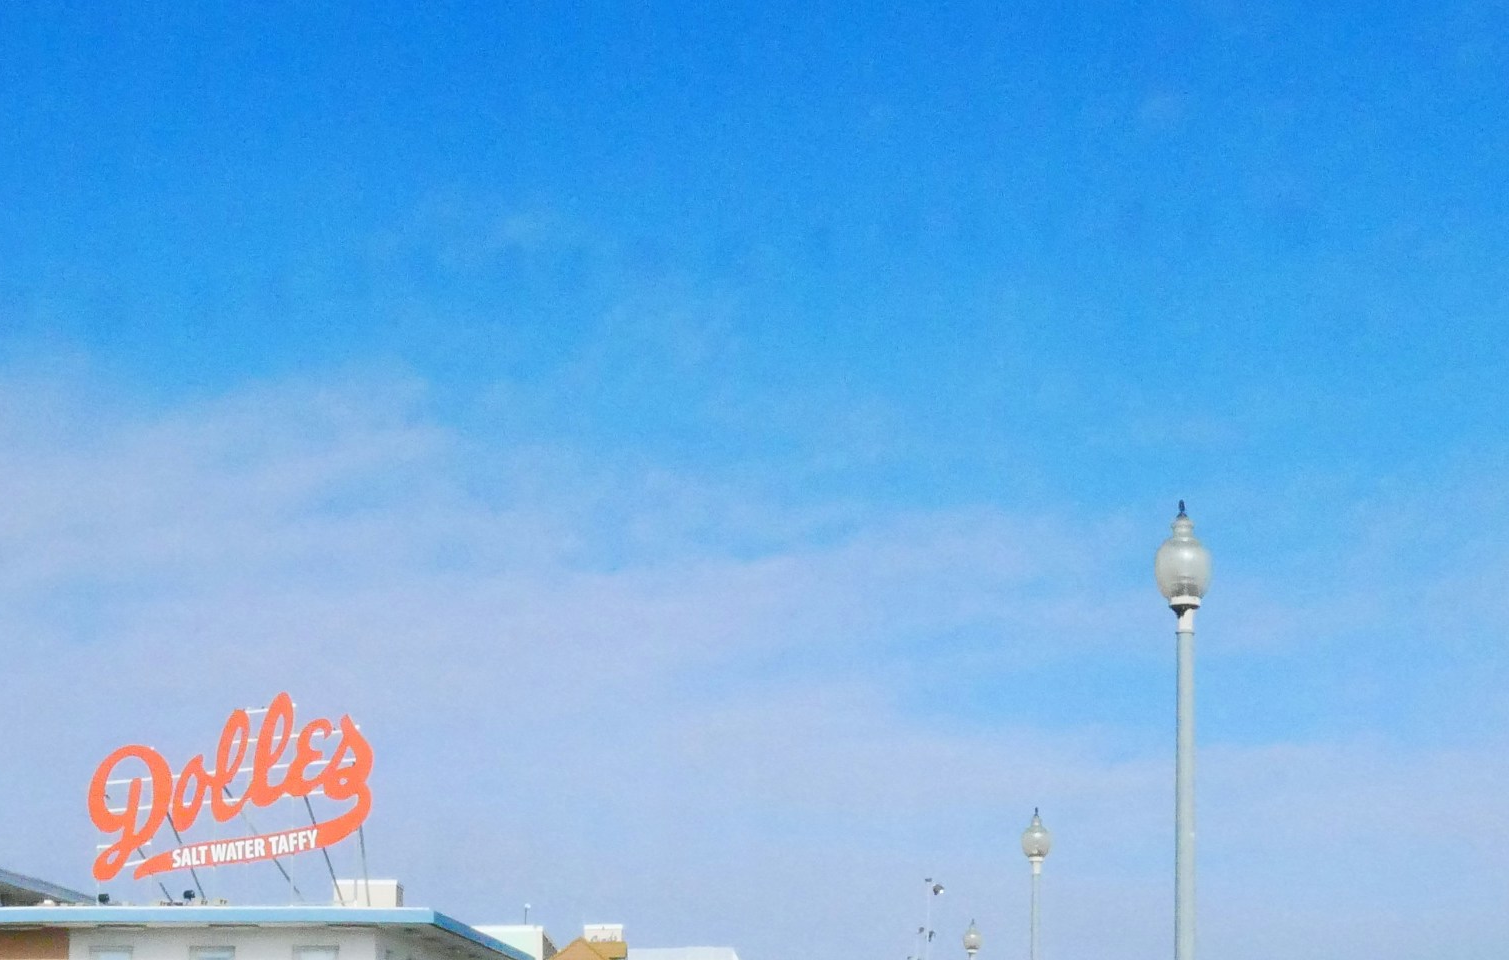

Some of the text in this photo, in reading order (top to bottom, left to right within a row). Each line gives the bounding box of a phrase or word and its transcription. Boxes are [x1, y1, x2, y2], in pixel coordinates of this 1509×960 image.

[88, 691, 374, 881] Dolles
[171, 829, 319, 868] SALT WATER TAFFY
